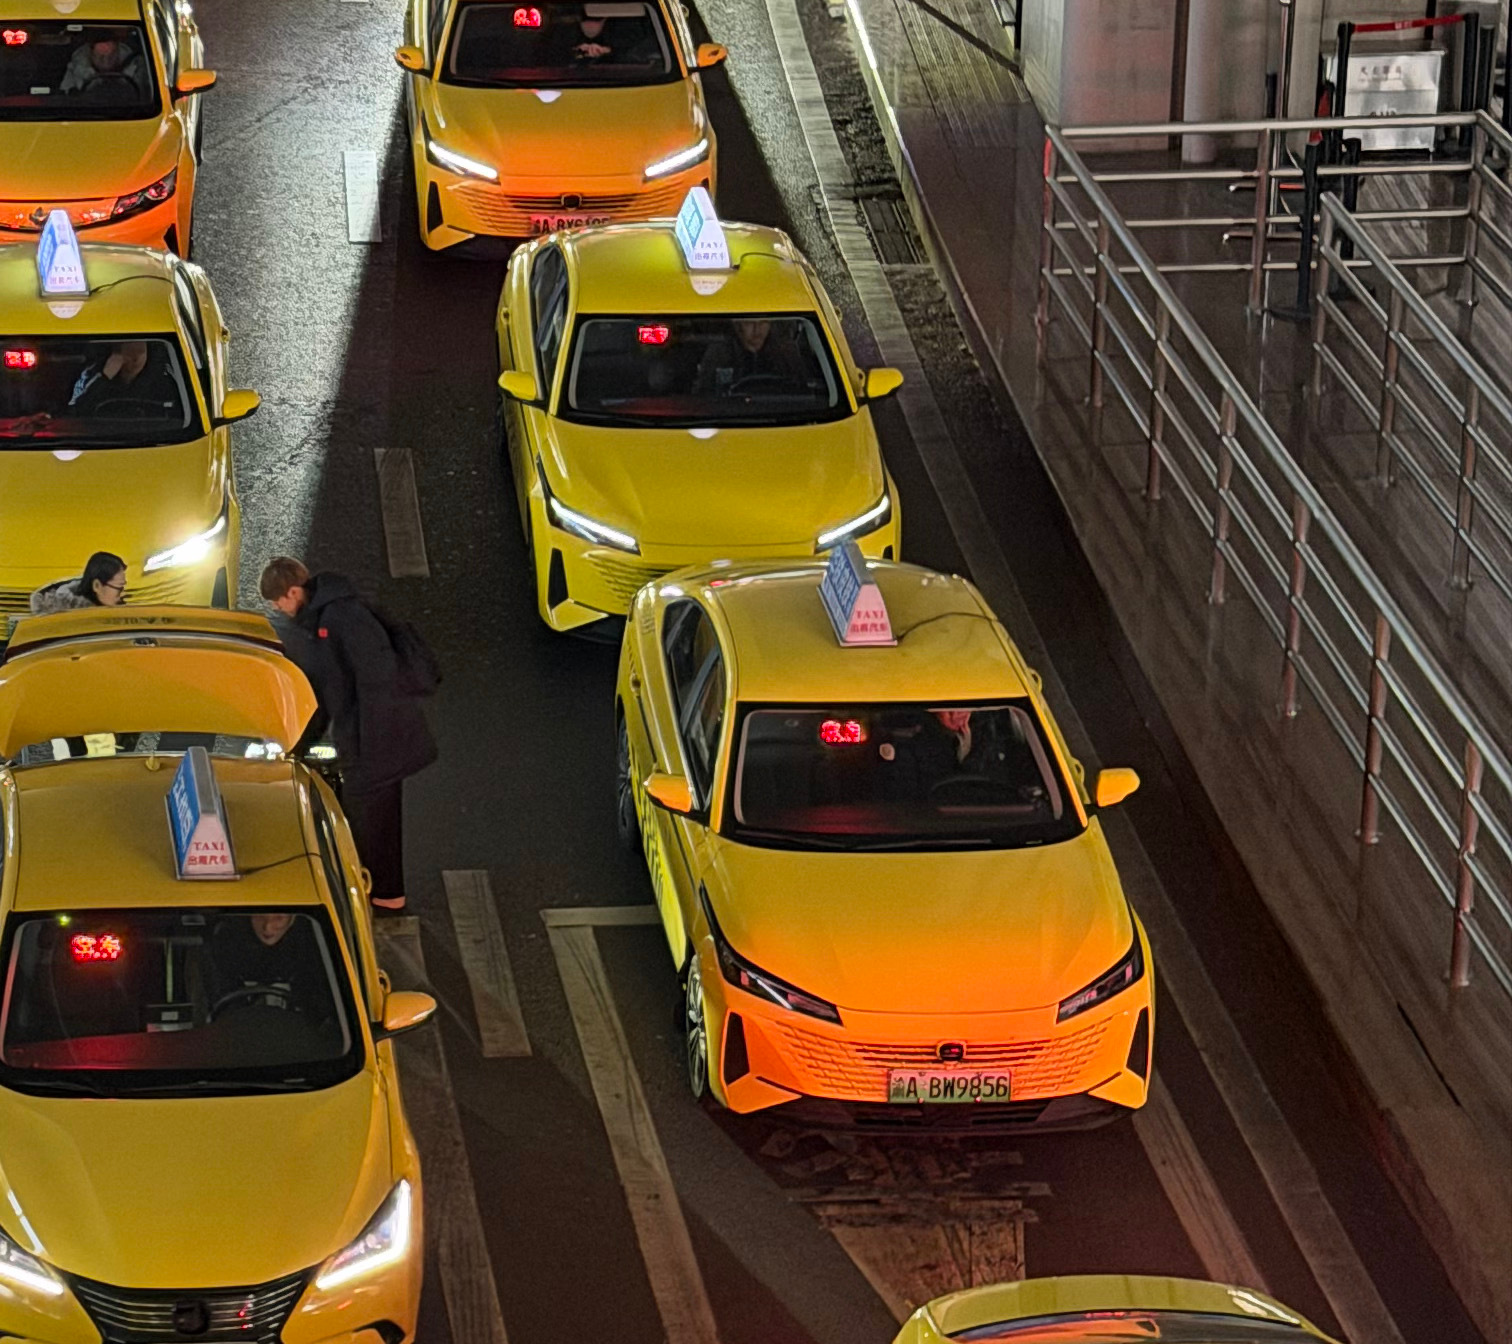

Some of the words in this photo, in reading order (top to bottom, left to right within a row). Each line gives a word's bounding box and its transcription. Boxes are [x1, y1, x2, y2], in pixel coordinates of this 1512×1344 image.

[856, 610, 884, 619] TAXI
[849, 622, 889, 633] 出租汽车
[192, 842, 225, 851] TAXI
[187, 854, 229, 866] 出租汽车
[929, 1075, 1009, 1099] BW9856
